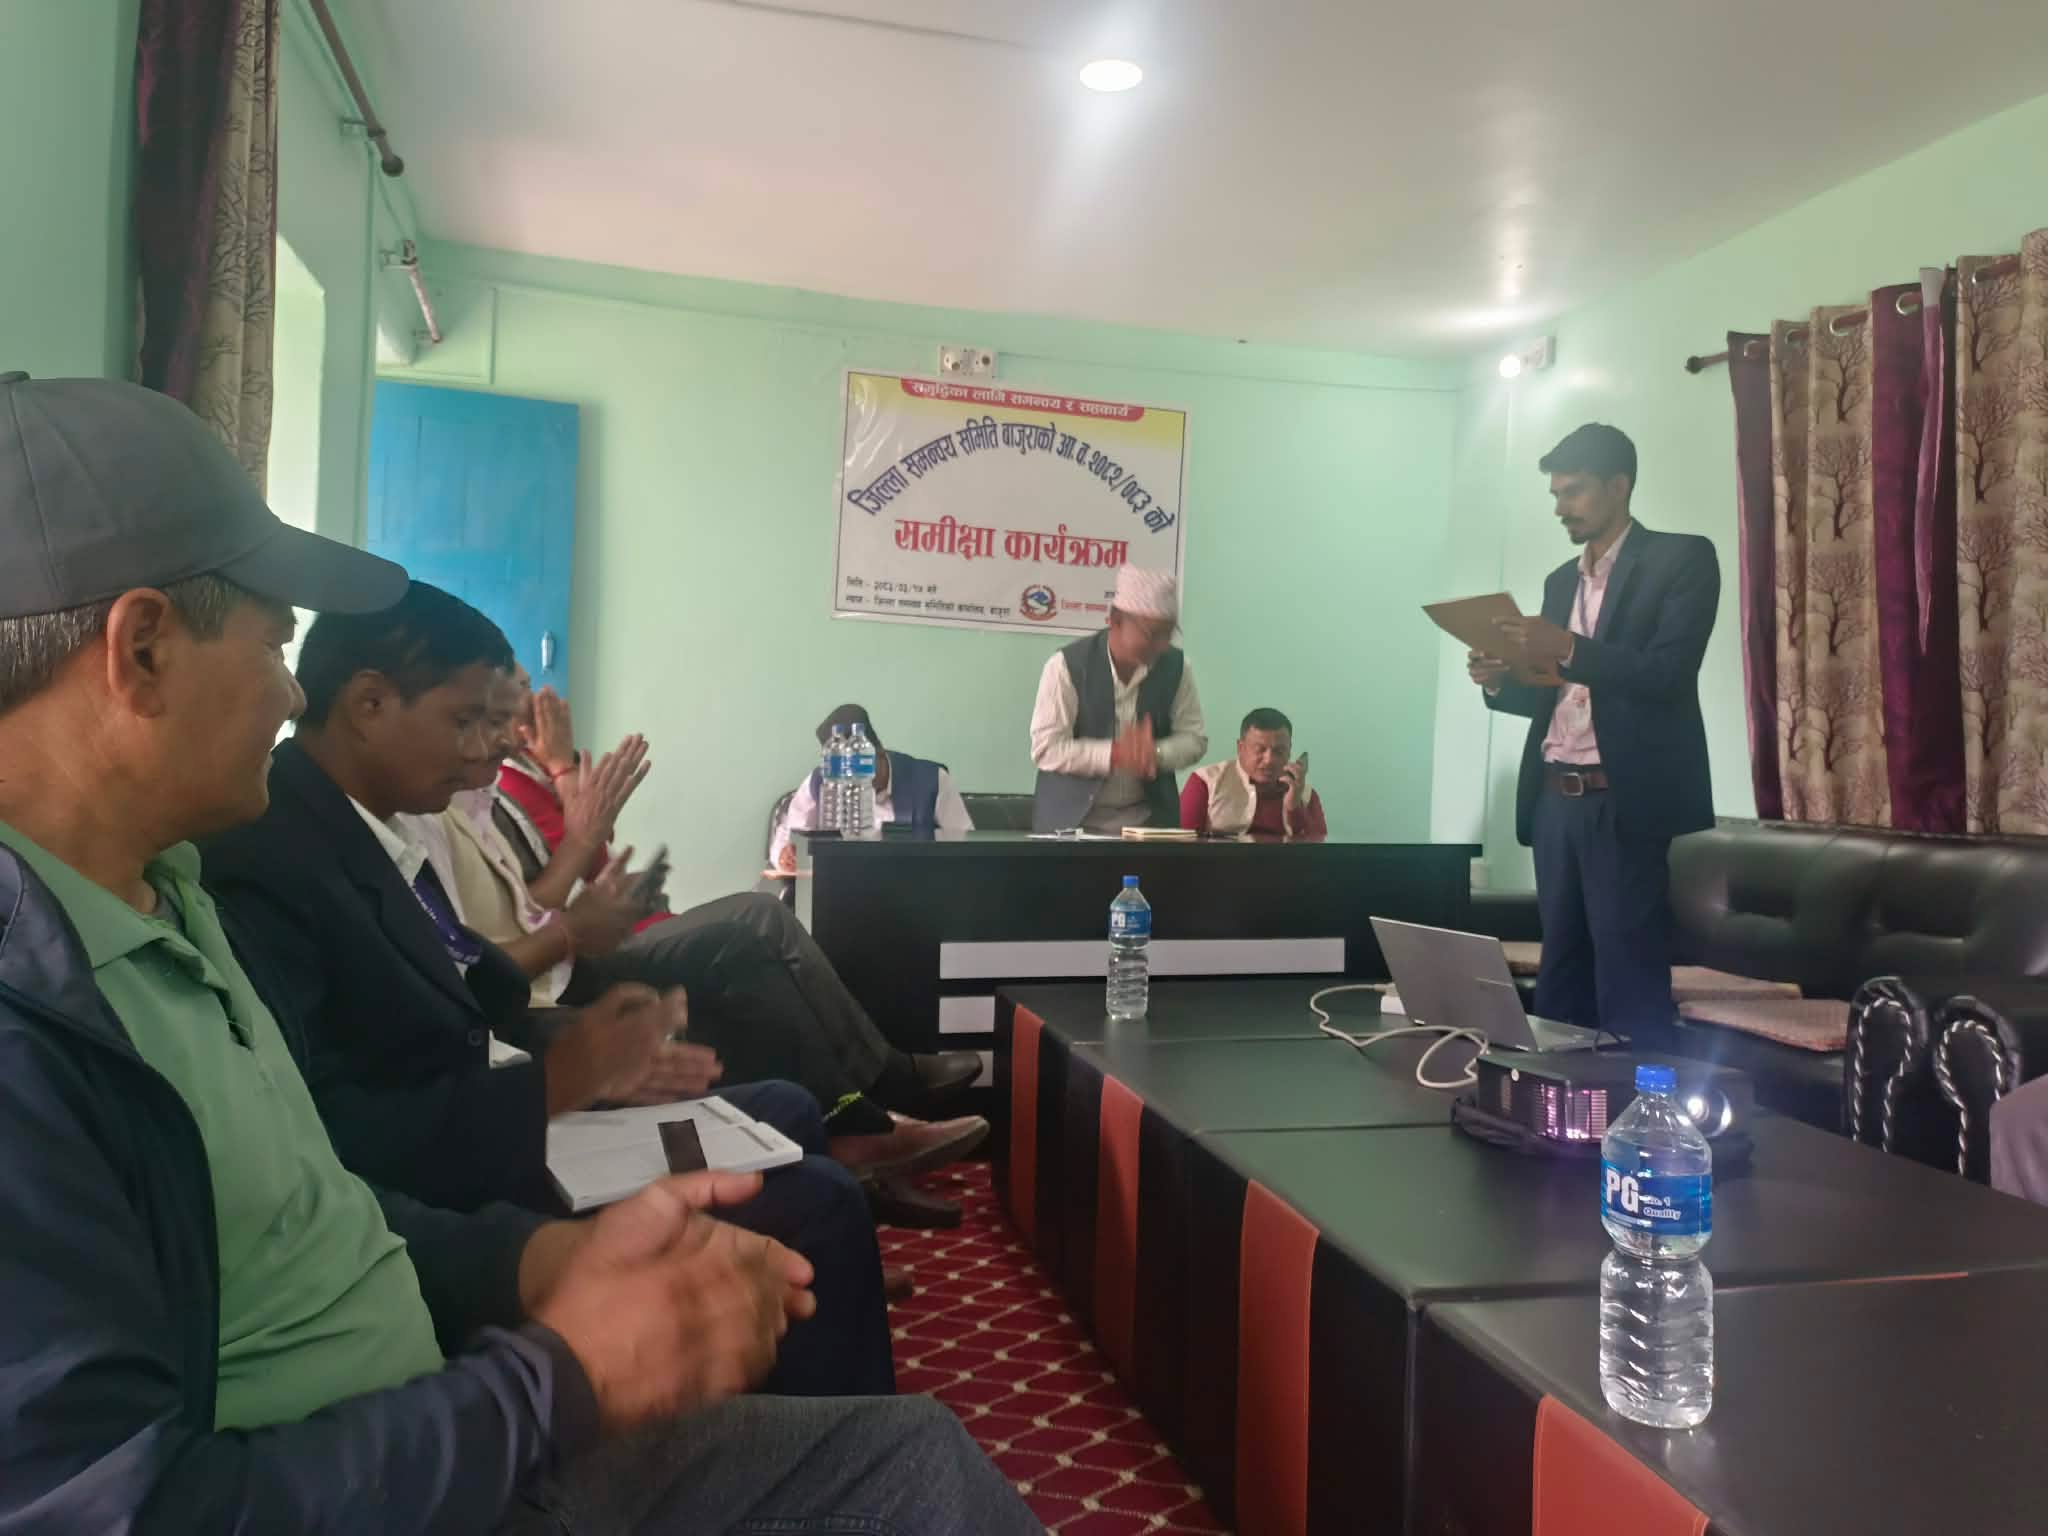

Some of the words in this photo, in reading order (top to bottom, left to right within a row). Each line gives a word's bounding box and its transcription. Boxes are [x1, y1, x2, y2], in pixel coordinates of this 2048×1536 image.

[847, 465, 910, 516] जिल्ला
[899, 433, 958, 479] समन्वय
[956, 416, 999, 455] समिति
[1144, 506, 1175, 533] को
[895, 515, 997, 560] समीक्षा
[1004, 523, 1129, 569] कार्यक्रम
[1606, 1167, 1639, 1214] PG
[1643, 1206, 1681, 1221] Quality
